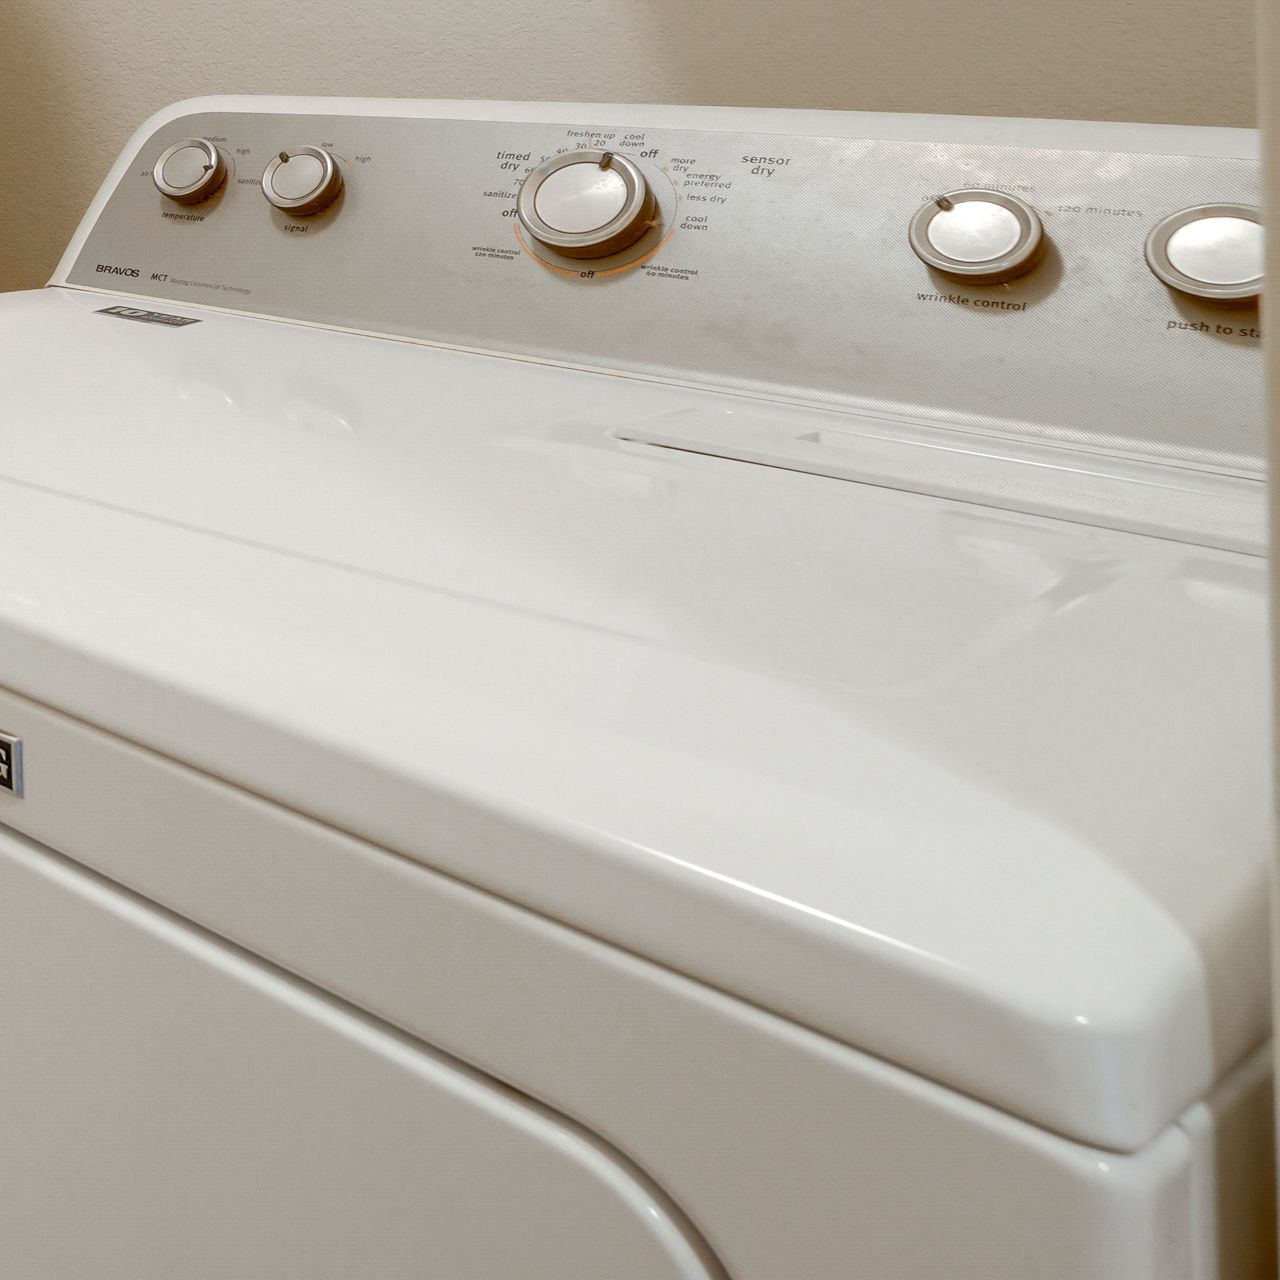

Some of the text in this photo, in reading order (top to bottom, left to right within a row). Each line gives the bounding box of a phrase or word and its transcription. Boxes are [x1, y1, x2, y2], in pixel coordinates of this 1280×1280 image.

[566, 130, 615, 140] freshen up
[619, 139, 645, 147] down
[236, 148, 250, 156] high
[496, 151, 531, 161] timed
[640, 149, 659, 158] off
[355, 155, 371, 163] high
[671, 157, 696, 165] more
[741, 155, 791, 166] sensor
[500, 161, 521, 172] dry
[673, 164, 689, 173] dry
[751, 166, 775, 177] dry
[686, 172, 722, 181] energy
[684, 180, 732, 189] preferred
[483, 190, 517, 199] sanitize
[687, 194, 727, 205] less dry
[162, 212, 204, 222] temperature
[502, 208, 519, 218] off
[1087, 206, 1143, 218] minutes
[685, 215, 707, 223] cool
[283, 223, 309, 233] signal
[680, 222, 709, 231] down
[472, 246, 521, 256] wrinkle control
[96, 264, 140, 278] BRAVOS
[151, 273, 168, 282] MCT
[580, 271, 595, 279] off
[640, 264, 698, 276] wrinkle control
[658, 272, 689, 280] minutes
[916, 292, 1027, 312] wrinkle control
[1166, 321, 1210, 333] push
[1216, 325, 1233, 336] to
